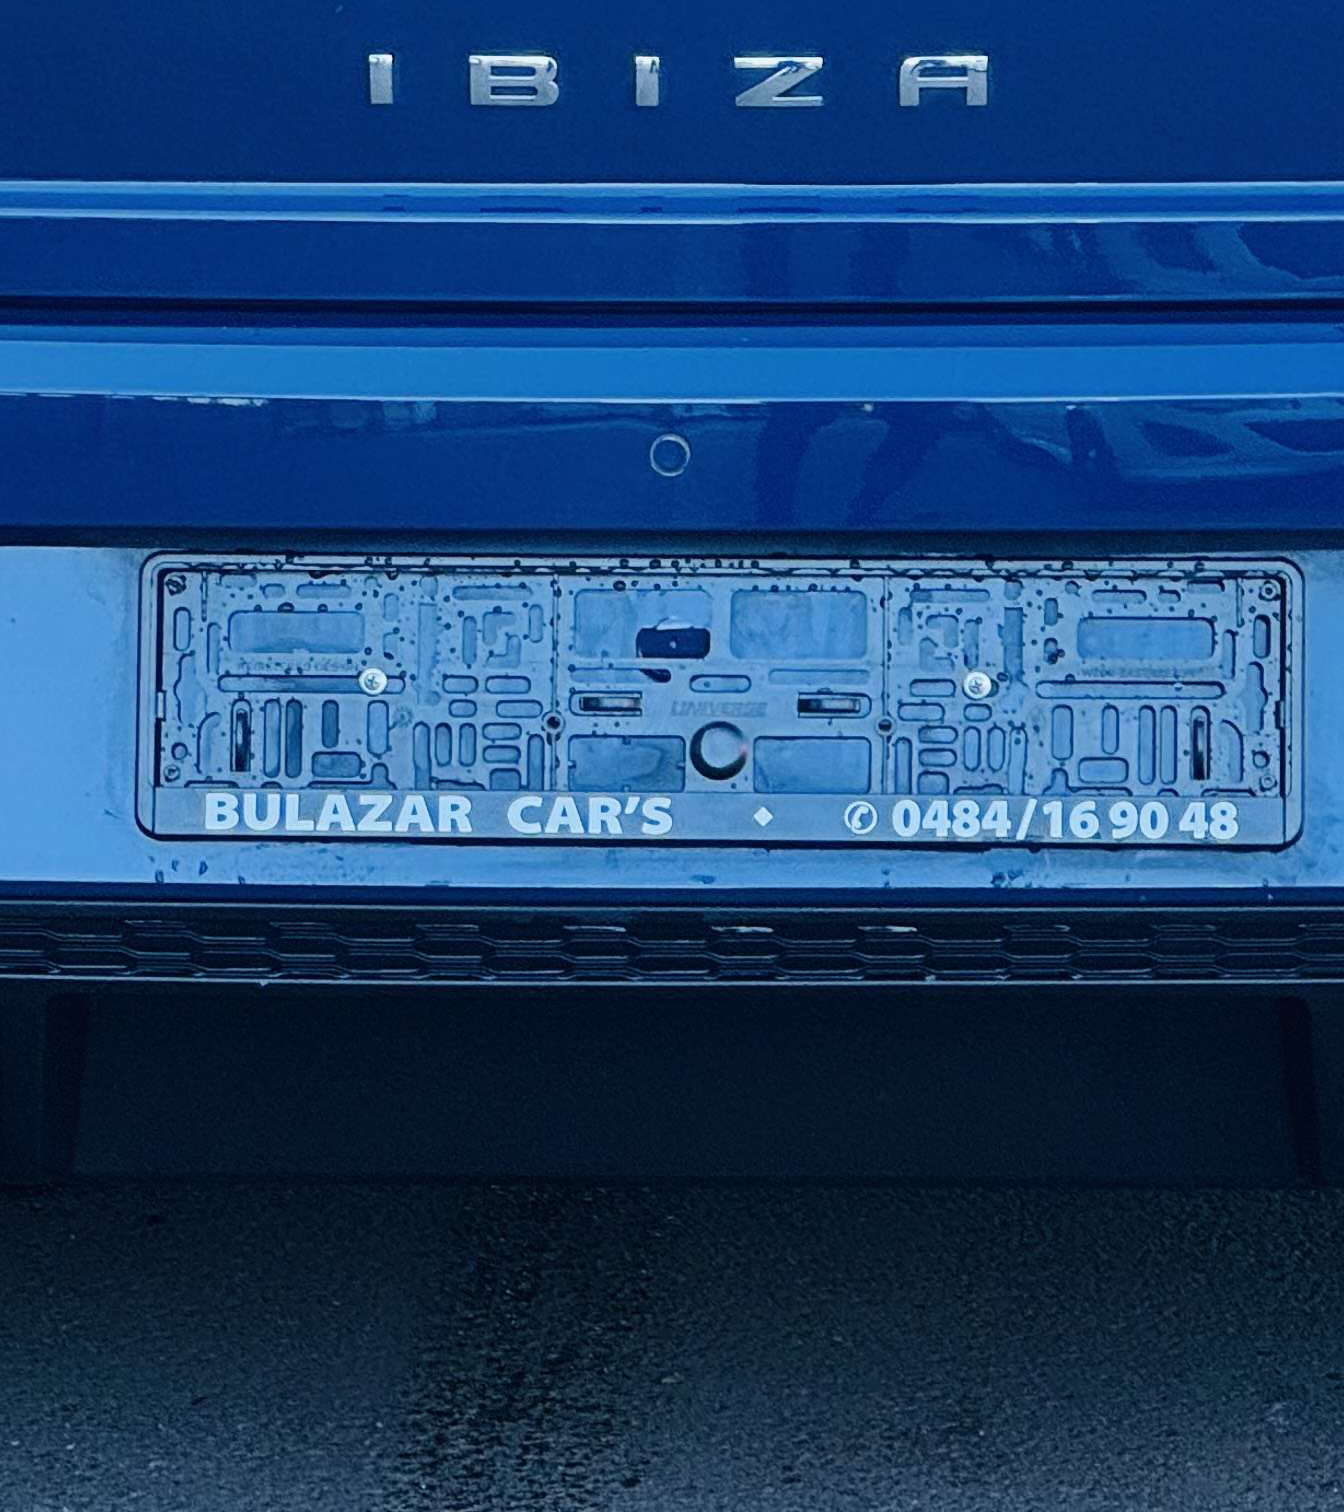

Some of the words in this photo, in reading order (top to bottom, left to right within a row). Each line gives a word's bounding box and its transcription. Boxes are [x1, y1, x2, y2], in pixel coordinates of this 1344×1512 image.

[368, 53, 990, 108] IBIZA
[203, 792, 473, 834] BULAZAR
[507, 795, 674, 836] CAR'S
[891, 798, 1100, 840] 0484/16
[1110, 800, 1169, 840] 90
[1178, 800, 1240, 840] 48
